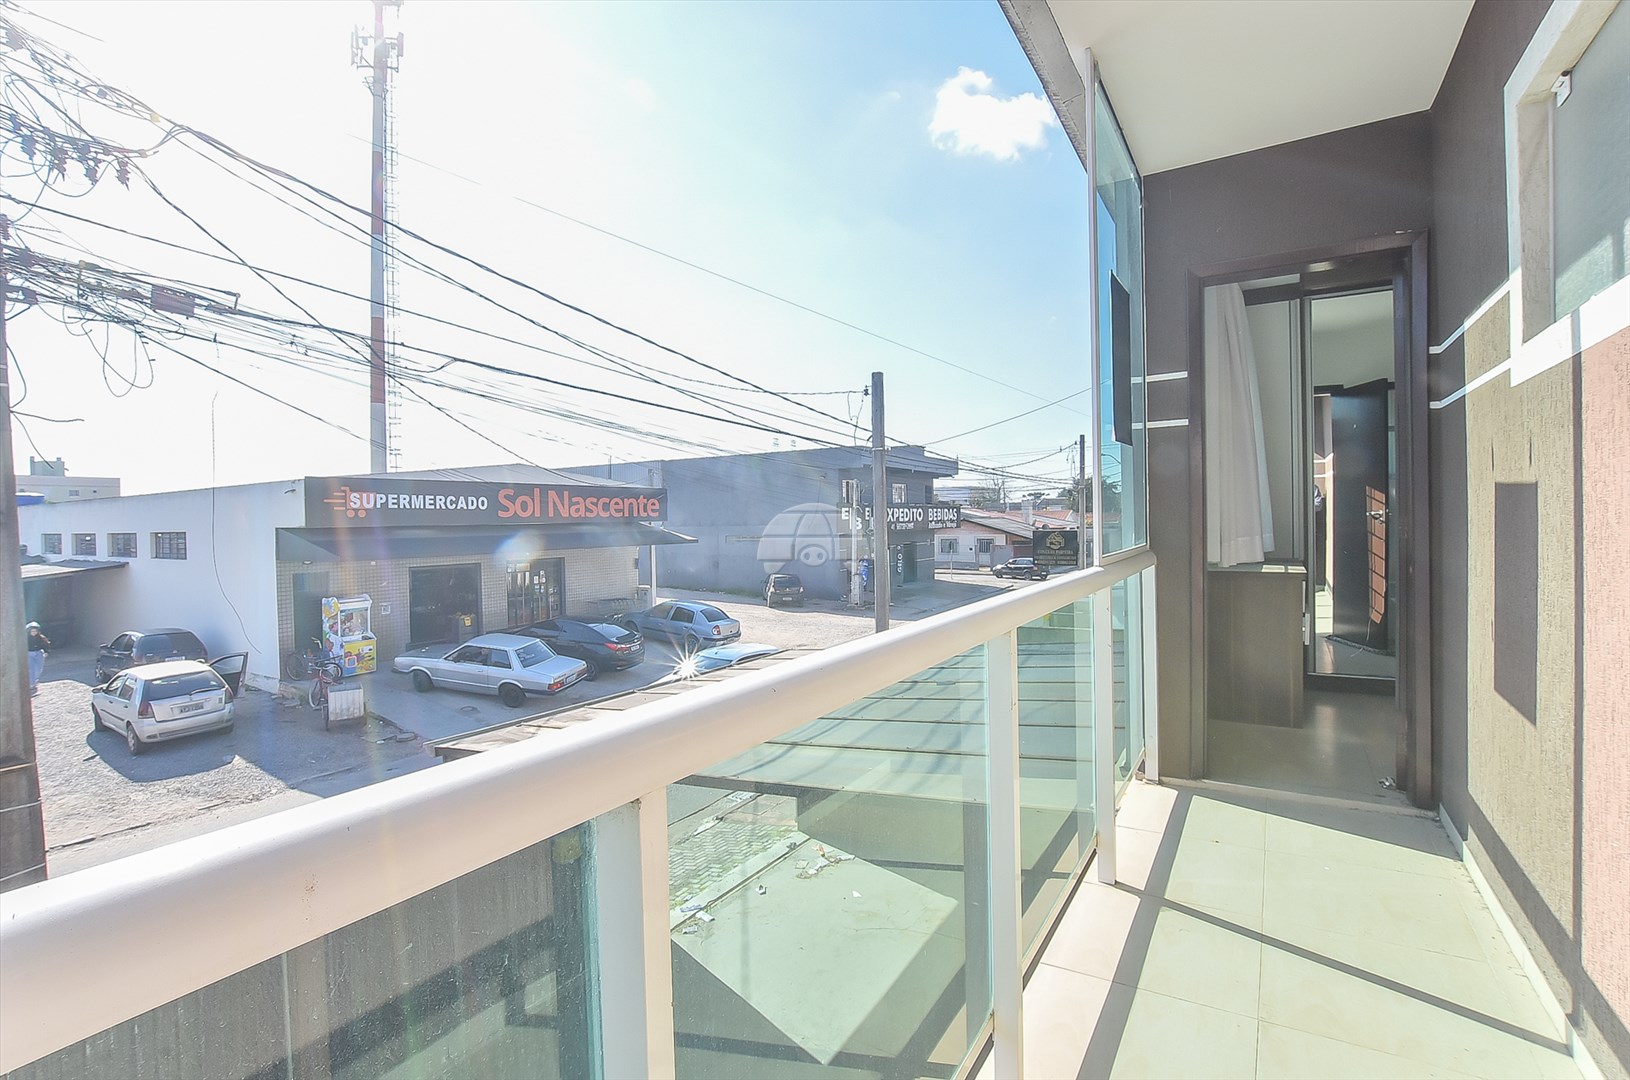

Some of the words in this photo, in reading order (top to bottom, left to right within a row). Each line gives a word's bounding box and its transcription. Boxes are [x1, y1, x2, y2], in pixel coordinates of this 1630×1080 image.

[349, 492, 488, 511] SUPERMERCADO
[498, 487, 541, 518] Sol
[548, 488, 660, 518] Nascente
[886, 507, 924, 522] XPEDITO
[928, 507, 958, 521] BEBIDAS
